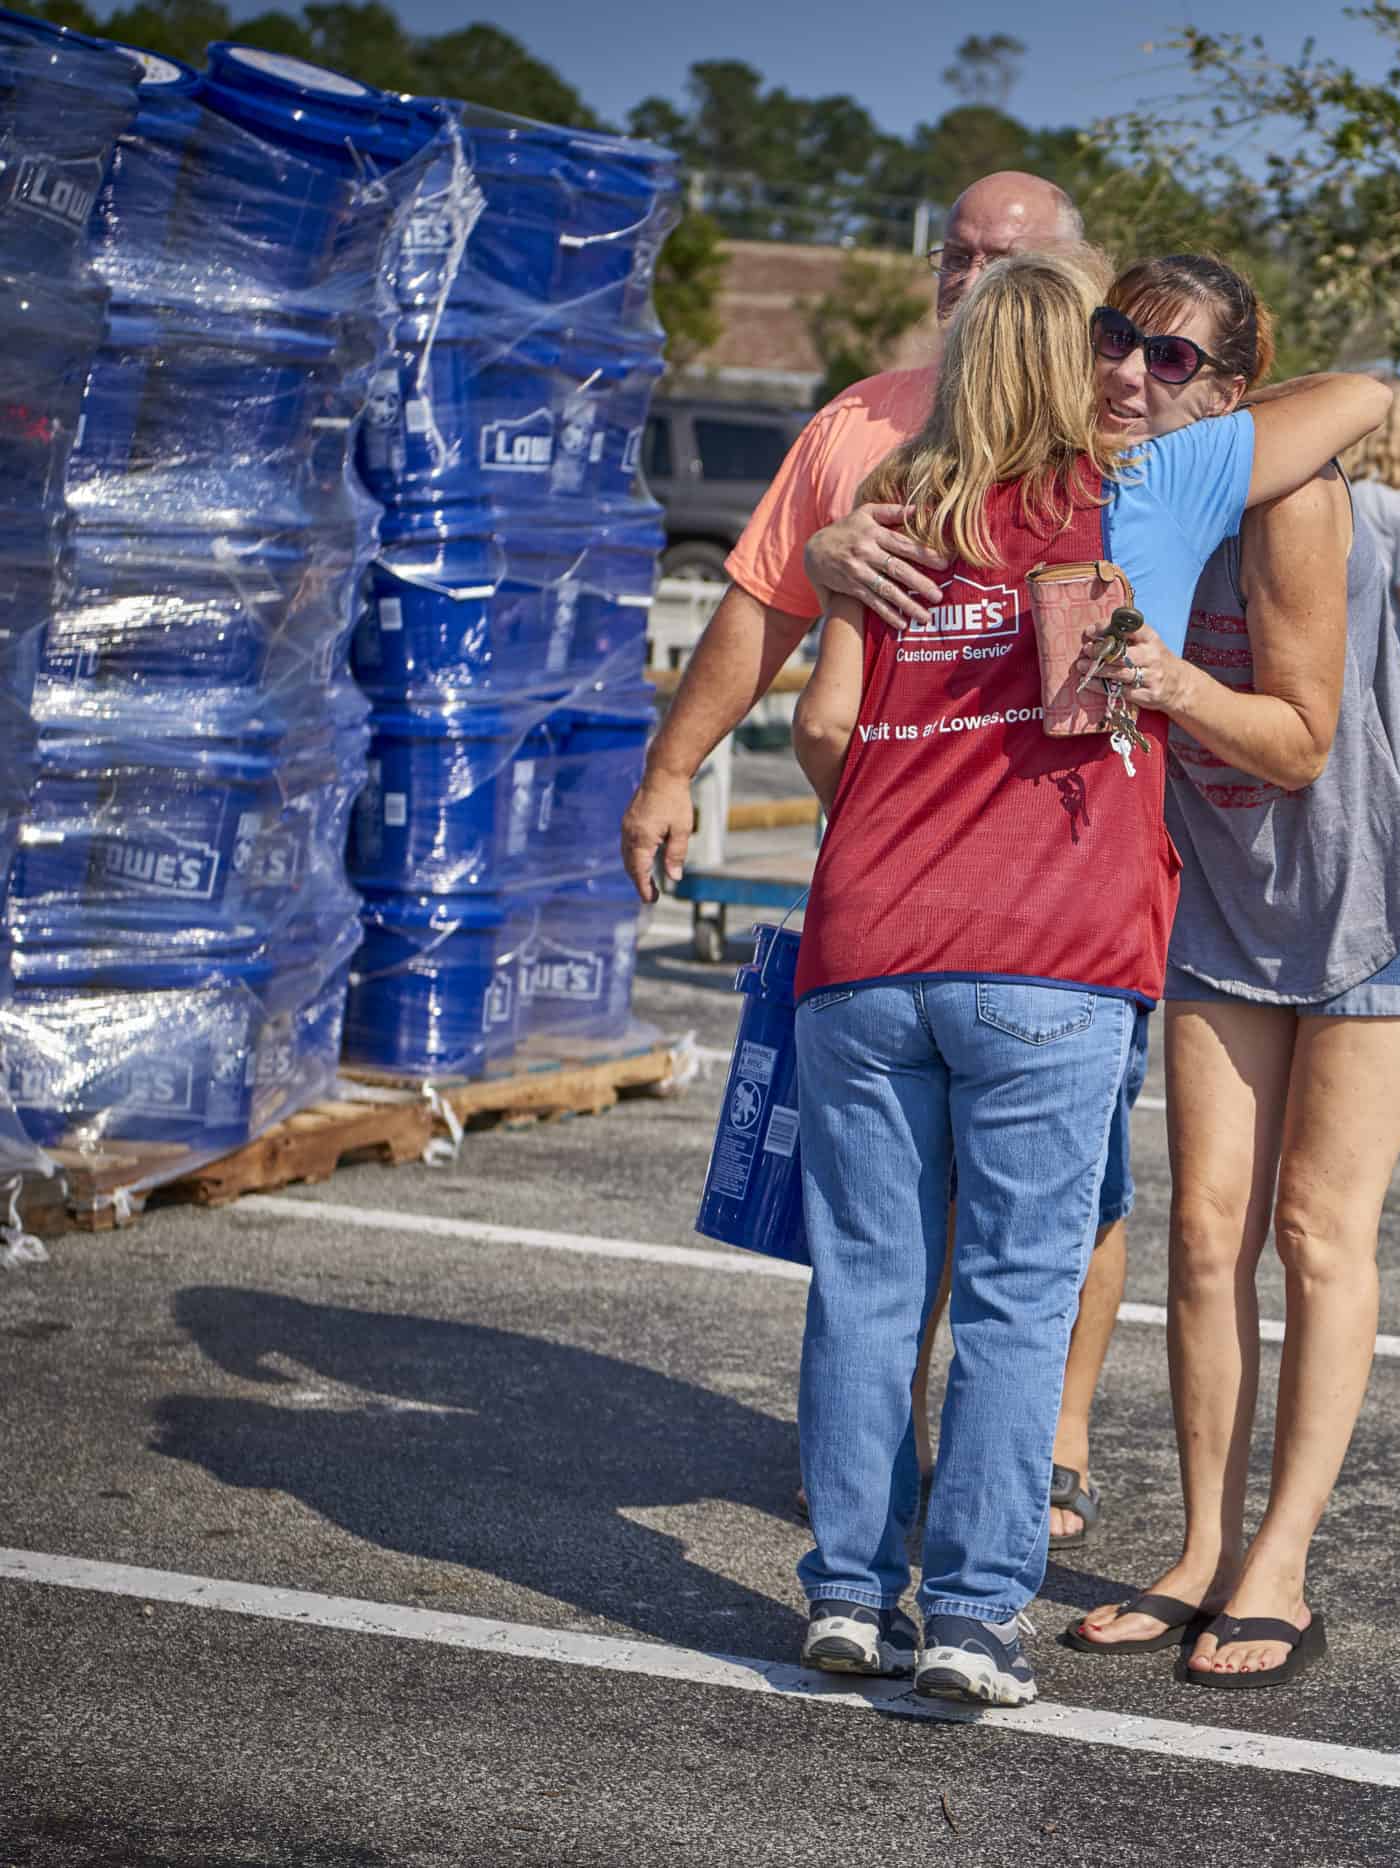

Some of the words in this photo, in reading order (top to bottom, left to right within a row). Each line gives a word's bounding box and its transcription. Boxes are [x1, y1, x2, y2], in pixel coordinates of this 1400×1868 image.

[896, 647, 959, 662] Customer
[859, 722, 890, 744] Visit
[895, 724, 918, 740] us
[106, 844, 202, 889] OWE'S
